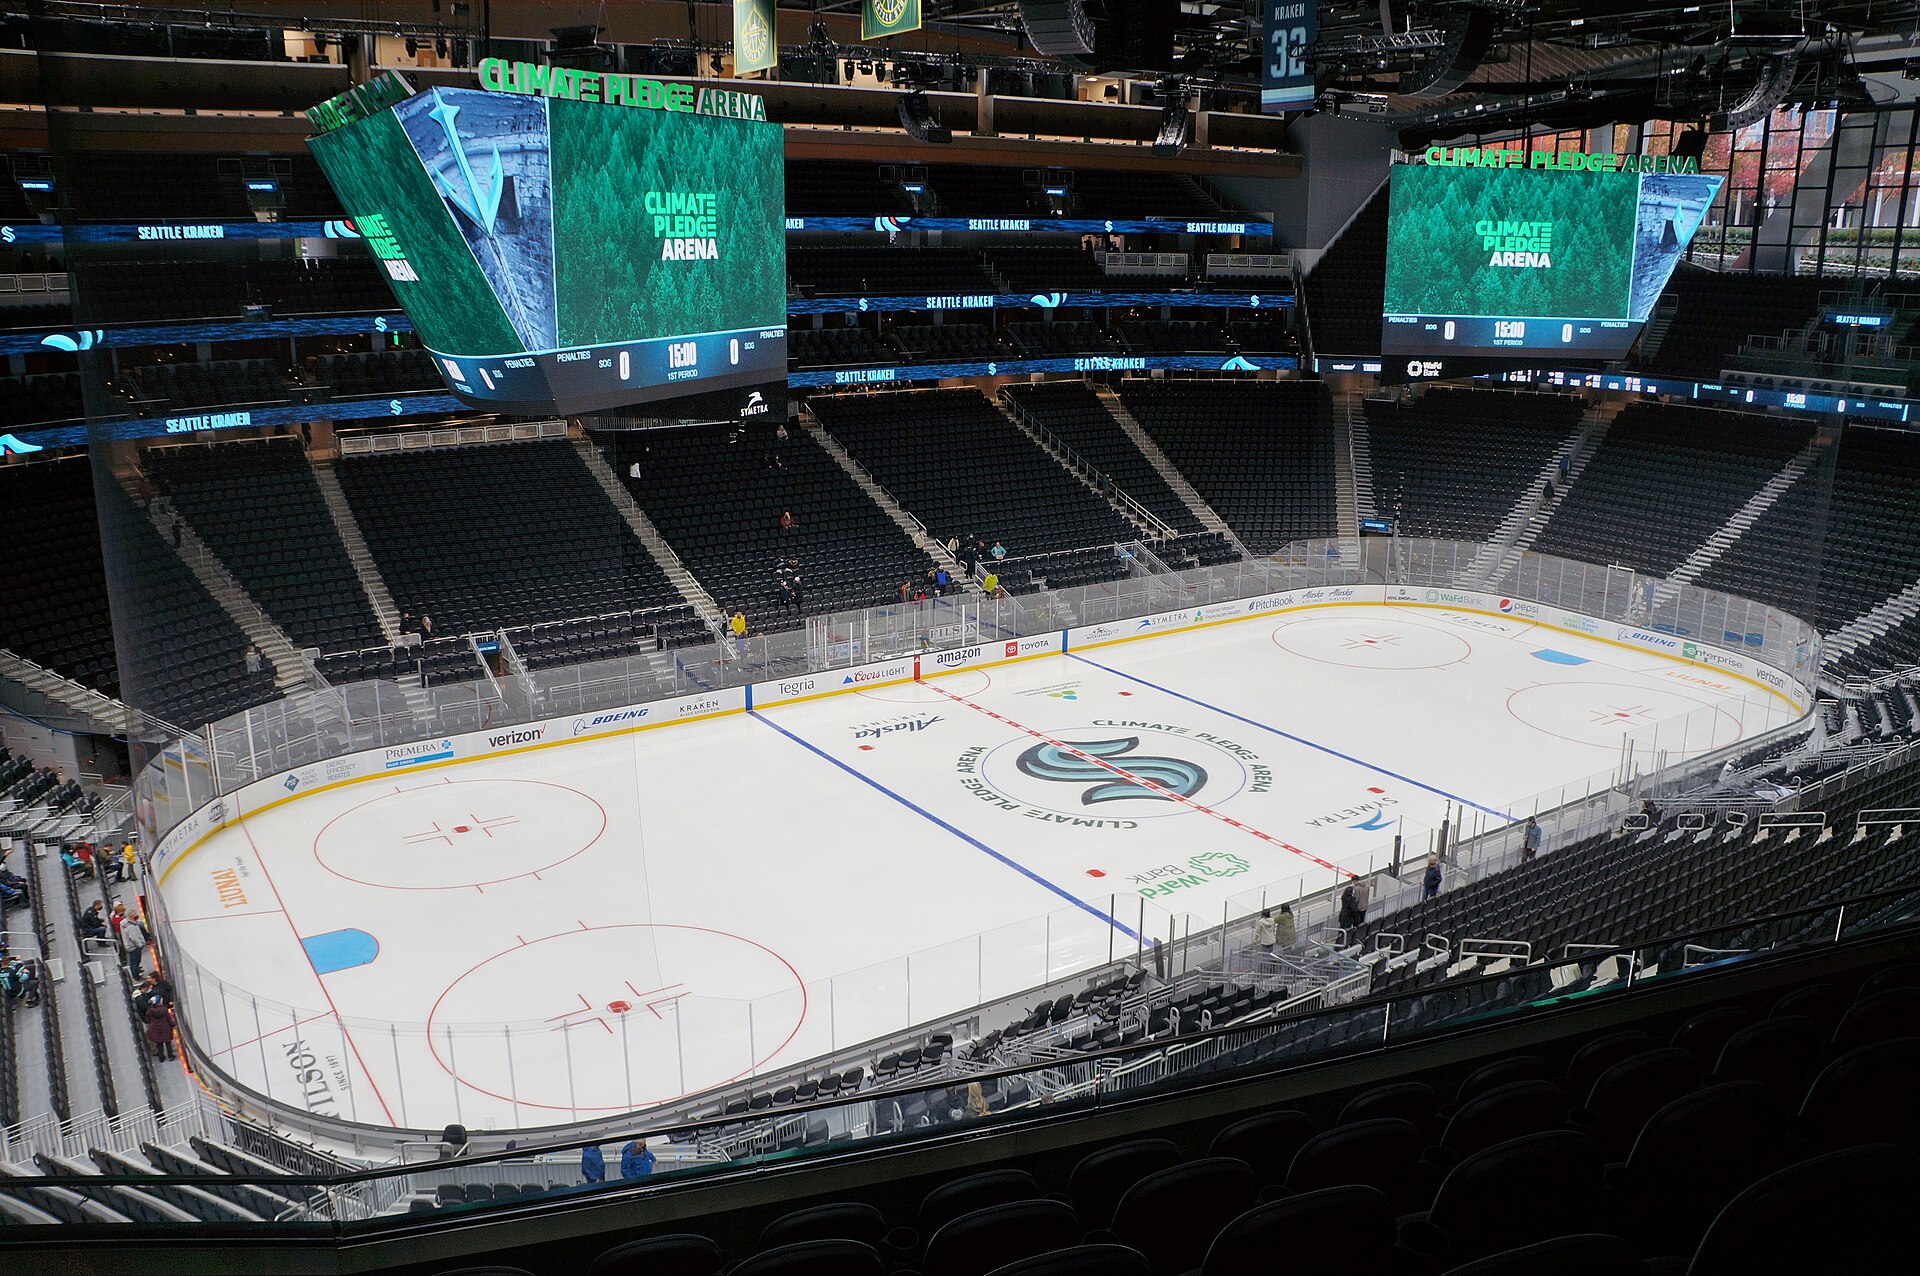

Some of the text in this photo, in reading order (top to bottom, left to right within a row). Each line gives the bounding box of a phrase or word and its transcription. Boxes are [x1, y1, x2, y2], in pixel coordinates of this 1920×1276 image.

[1274, 3, 1305, 20] KRAKEN
[1270, 26, 1306, 78] 32
[478, 57, 767, 121] CLIMATE PLEDGE ARENA
[1425, 146, 1699, 174] CLIMATE PLEDGE ARENA
[644, 191, 716, 215] CLIMATE
[138, 225, 224, 239] SEATTLE KRAKEN
[653, 215, 717, 238] PLEDGE
[968, 219, 1030, 231] SEATTLE KRAKEN
[1186, 222, 1245, 234] SEATTLE KRAKEN
[1475, 220, 1552, 238] CLIMATE
[661, 238, 719, 260] ARENA
[1483, 236, 1552, 253] PLEDGE
[1488, 252, 1551, 268] ARENA
[926, 295, 994, 309] SEATTLE KRAKEN
[1388, 316, 1418, 324] PENALTIES
[1425, 323, 1437, 331] SOG
[1600, 320, 1629, 328] PENALTIES
[759, 329, 784, 339] PENALTIES
[1443, 320, 1455, 341] 0
[1494, 320, 1525, 338] 15:00
[1561, 323, 1573, 343] 0
[1579, 326, 1591, 334] SOG
[729, 338, 739, 365] 0
[744, 341, 755, 350] SOG
[504, 357, 536, 369] PENALTIES
[556, 350, 591, 363] PENALTIES
[667, 341, 697, 369] 15:00
[598, 358, 612, 369] SOG
[619, 351, 630, 381] 0
[1422, 361, 1442, 370] WaFd
[667, 368, 698, 381] 1ST PERIOD
[835, 368, 895, 383] SEATTLE KRAKEN
[1423, 369, 1440, 377] Bank
[740, 403, 769, 417] SYMETRA
[166, 411, 251, 433] SEATTLE KRAKEN
[1301, 590, 1324, 599] Alaska
[1328, 588, 1354, 597] Alaska
[1440, 593, 1464, 603] WaFd
[1255, 596, 1294, 611] PitchBook
[1514, 602, 1539, 614] pepsi
[1152, 613, 1188, 626] SYMETRA
[1020, 639, 1049, 651] TOYOTA
[1631, 632, 1677, 648] BOEING
[936, 646, 981, 664] amazon
[1687, 647, 1743, 668] enterprise
[854, 666, 906, 682] Coors LIGHT
[1756, 668, 1784, 688] verizon
[778, 678, 815, 696] Tegria
[680, 700, 719, 712] KRAKEN
[591, 708, 649, 726] BOEING
[848, 712, 926, 731] AIRLINES
[854, 715, 945, 739] Alaska
[488, 726, 541, 748] verizon
[386, 744, 436, 760] PREMERA
[1092, 719, 1272, 794] CLIMATE PLEDGE ARENA
[326, 760, 347, 768] ENERGY
[956, 744, 1138, 830] CLIMATE PLEDGE ARENA
[1304, 796, 1399, 829] SYMETRA
[164, 819, 200, 854] SYMETRA
[1125, 863, 1186, 886] Bank
[1136, 873, 1210, 900] WaFd
[325, 1055, 350, 1092] SINCE 1897
